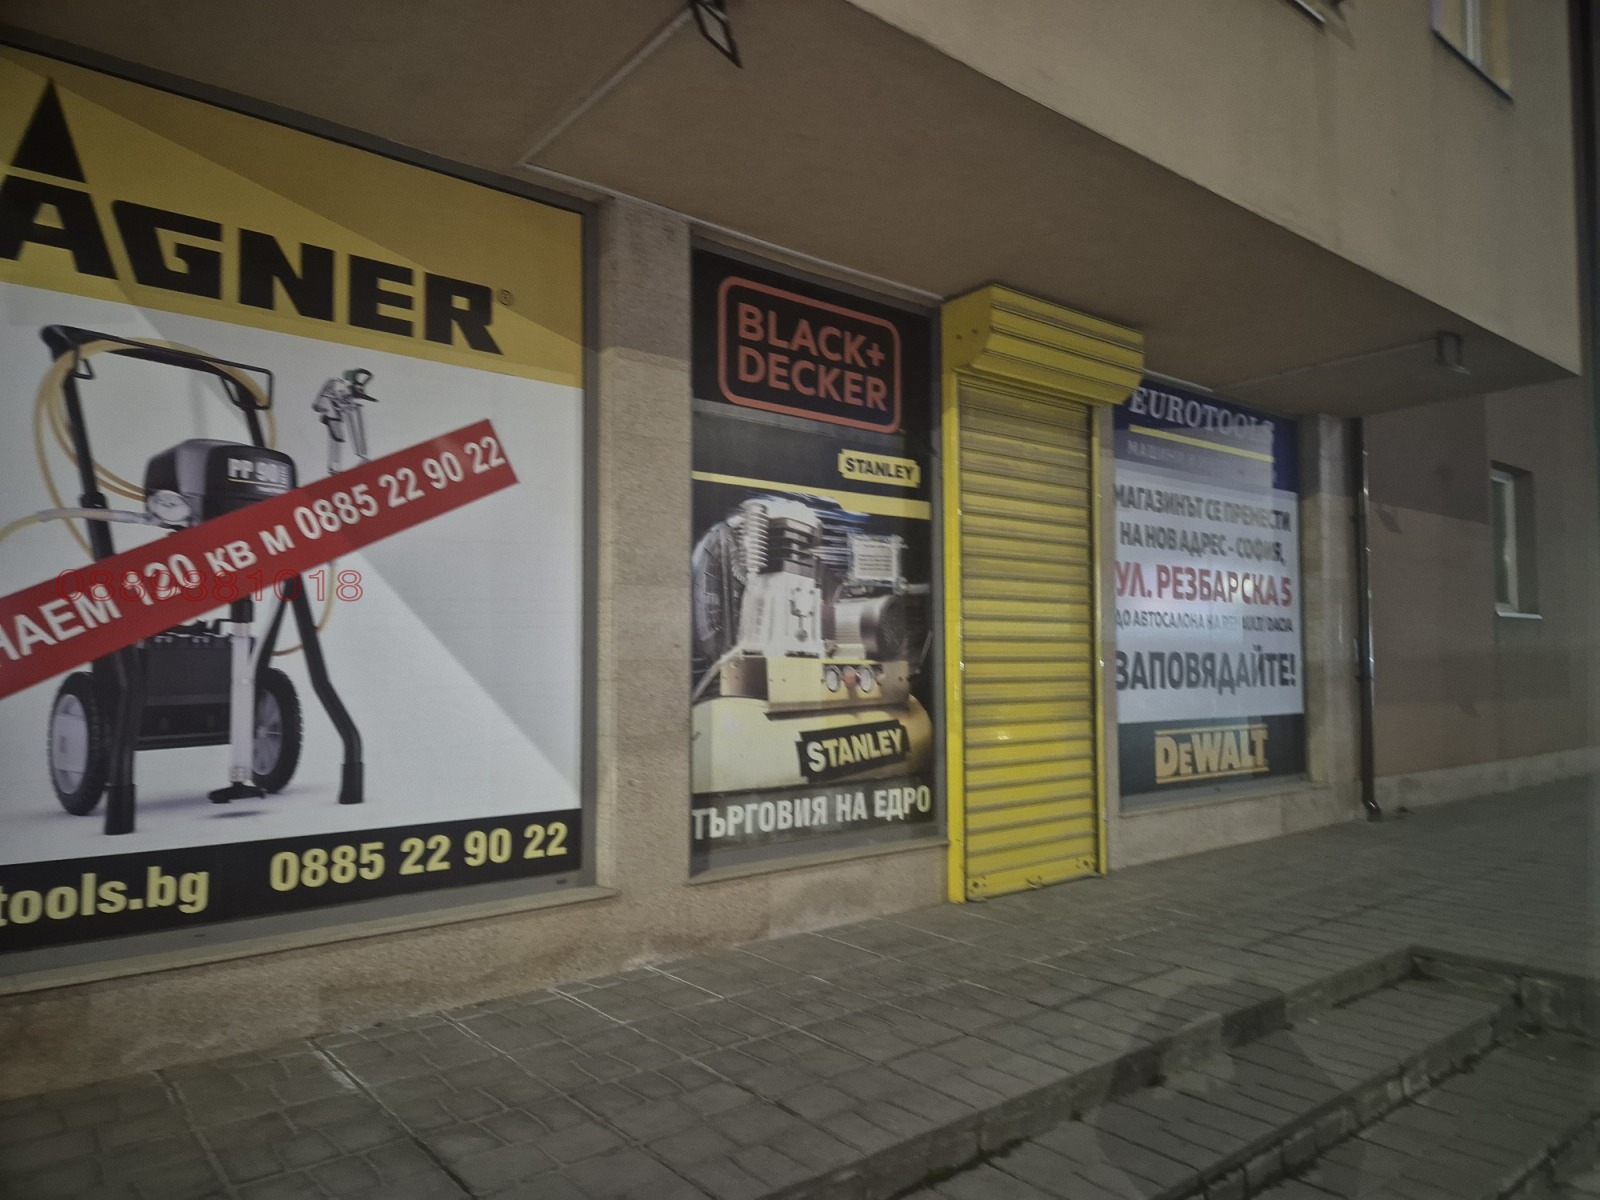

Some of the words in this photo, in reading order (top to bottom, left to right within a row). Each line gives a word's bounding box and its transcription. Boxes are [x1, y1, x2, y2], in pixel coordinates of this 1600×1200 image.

[737, 302, 886, 369] BLACK+
[737, 345, 888, 412] DECKER
[1128, 387, 1275, 440] EUROTOOLS
[293, 484, 379, 540] 0885
[378, 467, 425, 508] 22
[422, 451, 474, 489] 90
[464, 436, 506, 474] 22
[845, 456, 915, 480] STANLEY
[1205, 498, 1222, 522] СЕ
[1120, 521, 1144, 547] НА
[1144, 525, 1176, 551] НОВ
[1180, 529, 1228, 558] АДРЕС
[1115, 560, 1153, 597] УЛ.
[1155, 563, 1279, 606] РЕЗБАРСКА
[1280, 577, 1293, 608] 5
[1115, 645, 1296, 695] ЗАПОВЯДАЙТЕ!
[806, 728, 903, 773] STANLEY
[692, 793, 828, 840] ТЪРГОВИЯ
[836, 791, 867, 823] НА
[874, 785, 931, 821] ЕДРО
[270, 842, 385, 892] 0885
[400, 834, 451, 875] 22
[464, 827, 511, 867] 90
[523, 821, 568, 859] 22
